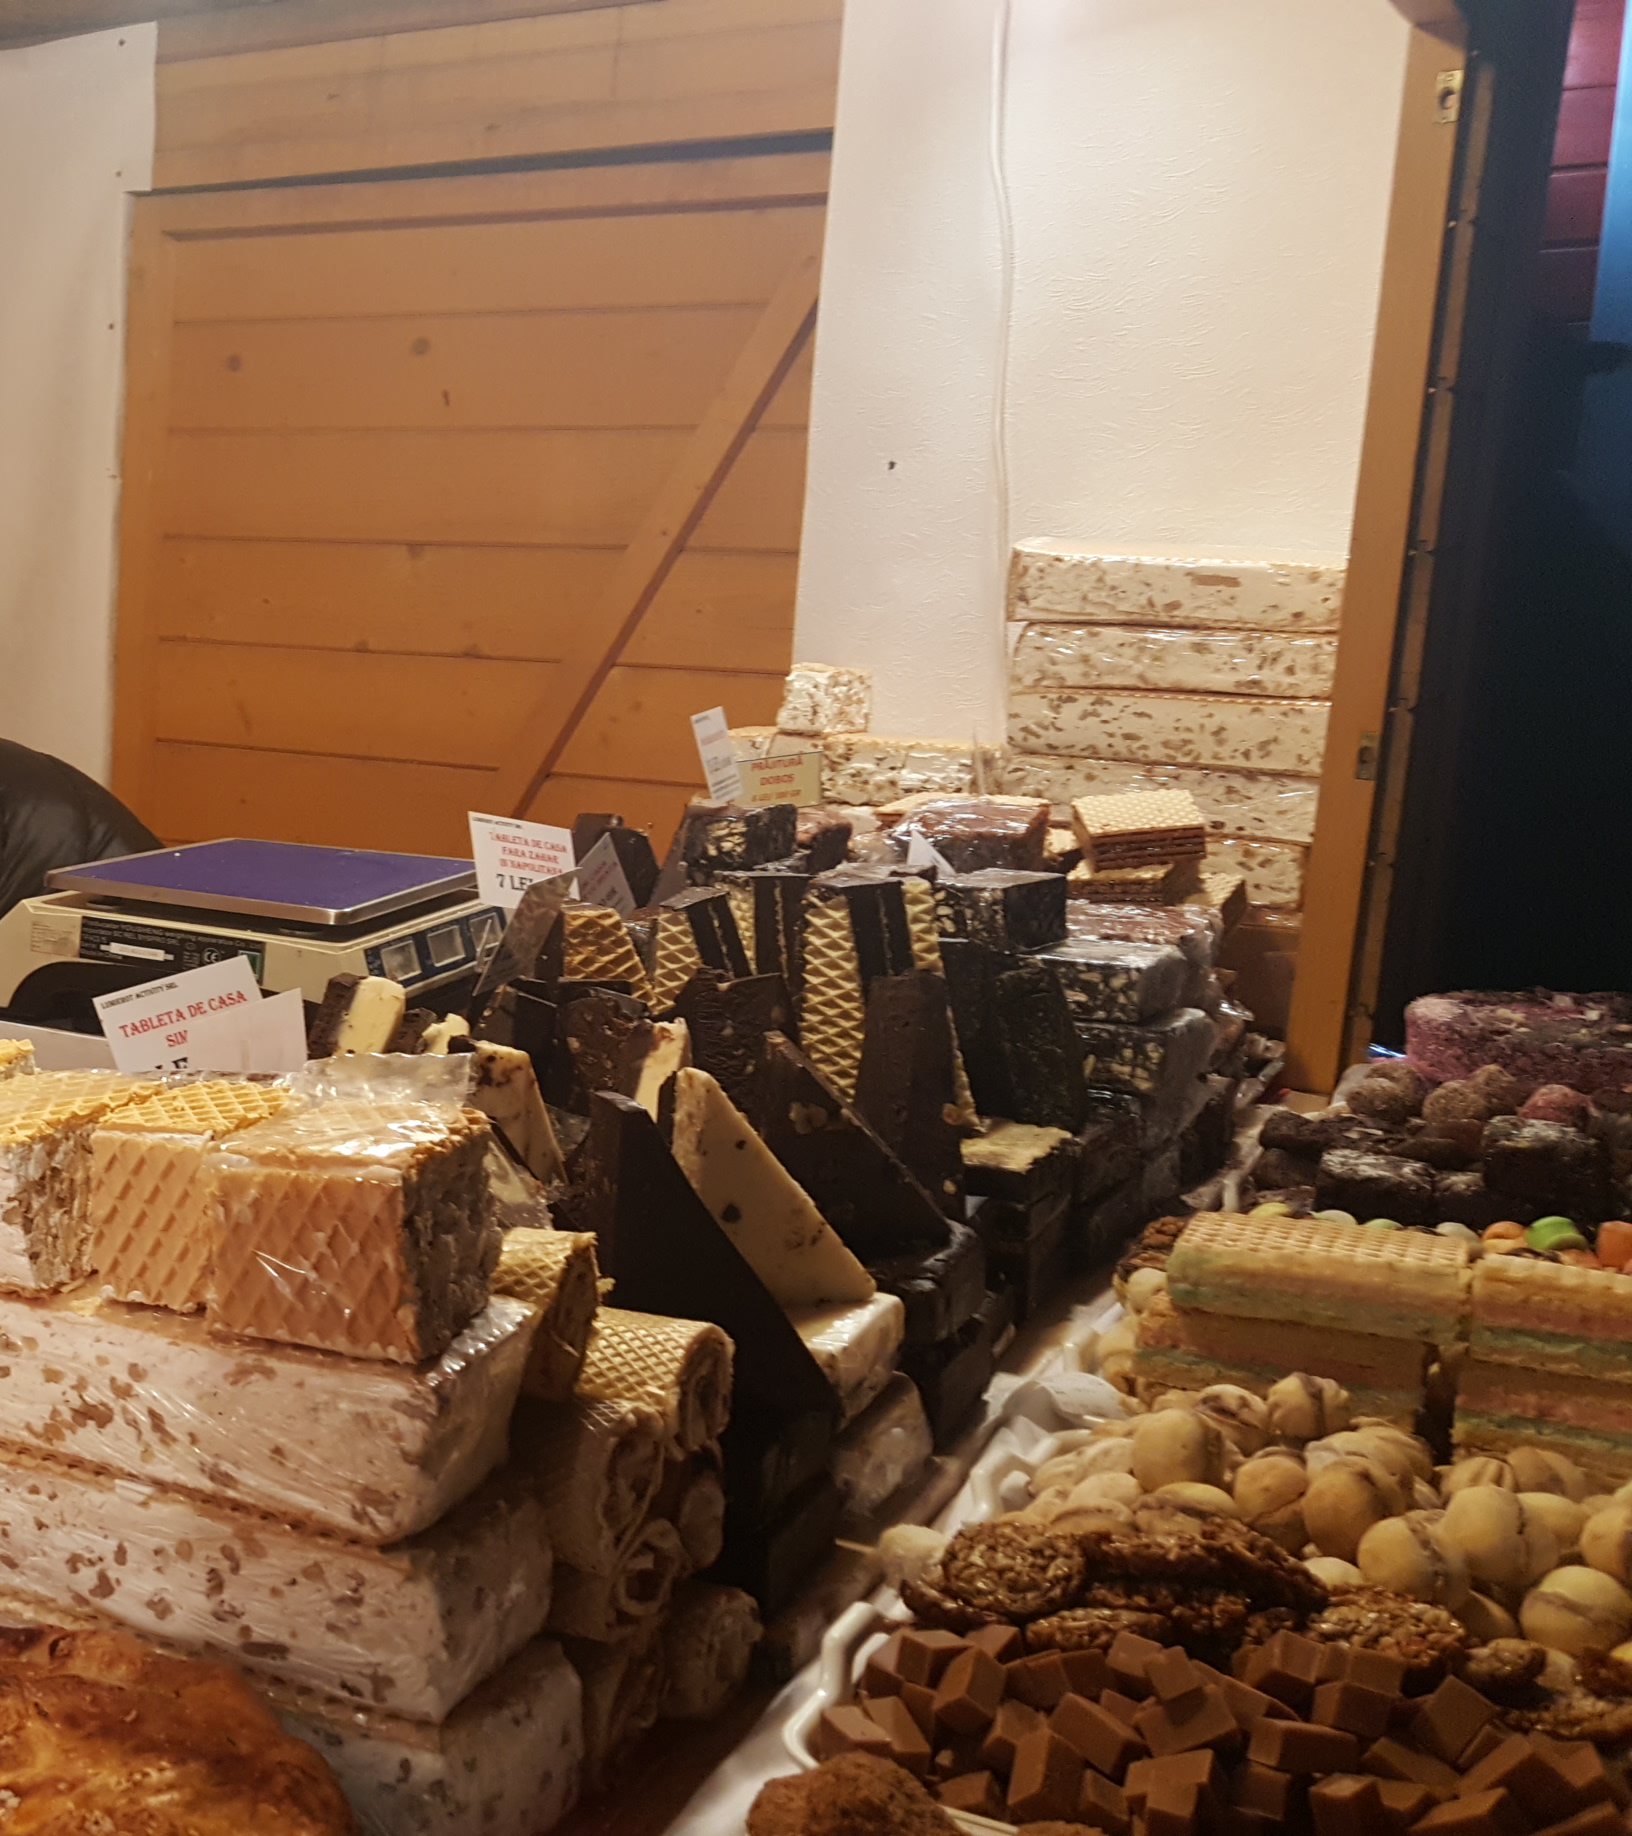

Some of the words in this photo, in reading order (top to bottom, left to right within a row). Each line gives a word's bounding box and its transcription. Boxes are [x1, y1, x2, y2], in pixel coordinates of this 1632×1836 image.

[531, 839, 543, 848] DE
[496, 873, 505, 888] 7
[509, 875, 533, 891] LE
[119, 1007, 187, 1038] TABLETA
[187, 1002, 208, 1018] DE
[209, 990, 248, 1012] CASA
